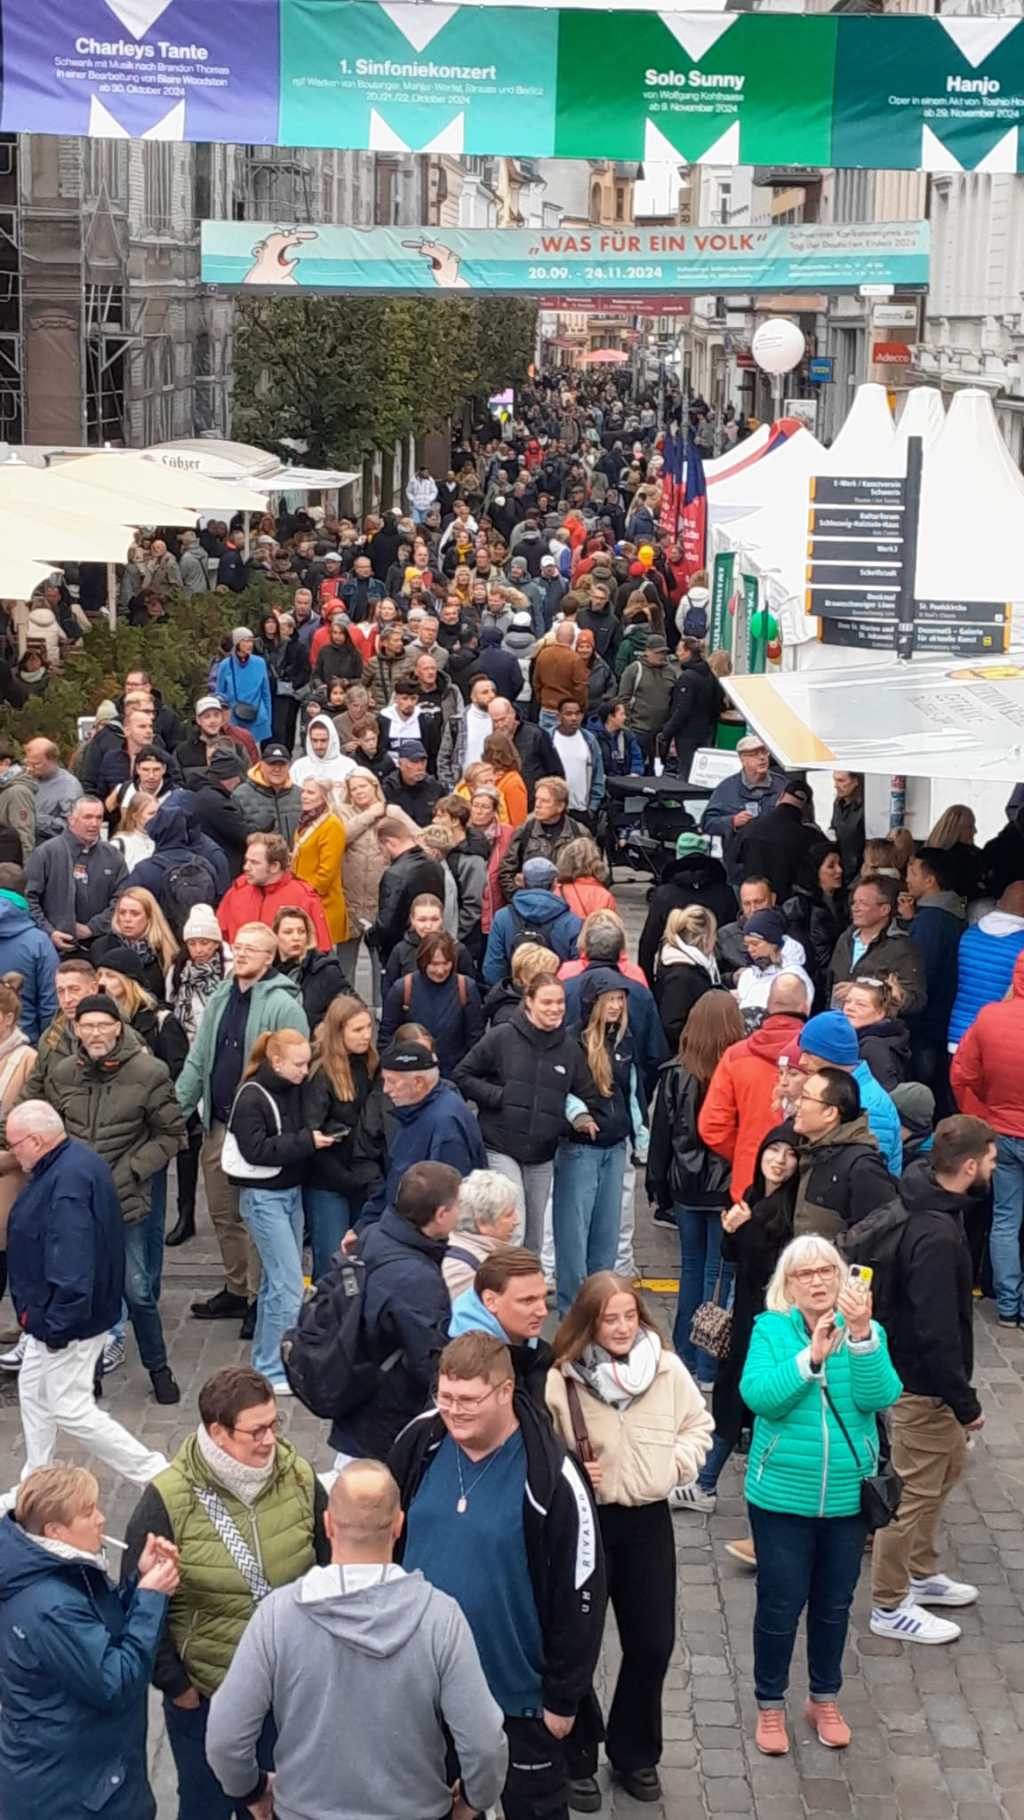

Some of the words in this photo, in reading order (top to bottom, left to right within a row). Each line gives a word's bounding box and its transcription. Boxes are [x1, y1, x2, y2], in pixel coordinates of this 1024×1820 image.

[75, 37, 154, 60] Charleys
[157, 42, 208, 60] Tante
[54, 56, 93, 67] Schwank
[94, 59, 108, 68] mit
[109, 59, 134, 69] Musik
[135, 61, 156, 70] nach
[157, 62, 194, 73] Brandon
[195, 63, 230, 75] Thomas
[339, 58, 352, 74] 1.
[355, 59, 496, 80] Sinfoniekonzert
[88, 70, 139, 84] Bearbeitung
[140, 74, 156, 83] von
[644, 69, 686, 86] Solo
[688, 70, 745, 91] Sunny
[99, 83, 111, 92] ab
[126, 84, 161, 94] Oktober
[163, 86, 185, 96] 2024
[946, 75, 1000, 96] Hanjo
[642, 91, 658, 99] von
[659, 90, 699, 102] Wolfgang
[888, 96, 911, 106] Oper
[912, 96, 921, 105] in
[921, 97, 947, 106] einem
[963, 98, 980, 106] von
[649, 102, 660, 111] ab
[669, 103, 714, 112] November
[715, 104, 738, 113] 2024
[923, 108, 934, 118] ab
[950, 108, 995, 118] November
[996, 109, 1020, 119] 2024
[528, 235, 591, 256] „WAS
[600, 231, 641, 252] FÜR
[650, 234, 685, 252] EIN
[527, 267, 572, 280] 20.09.
[585, 267, 663, 280] 24.11.2024
[875, 352, 910, 362] Adecco
